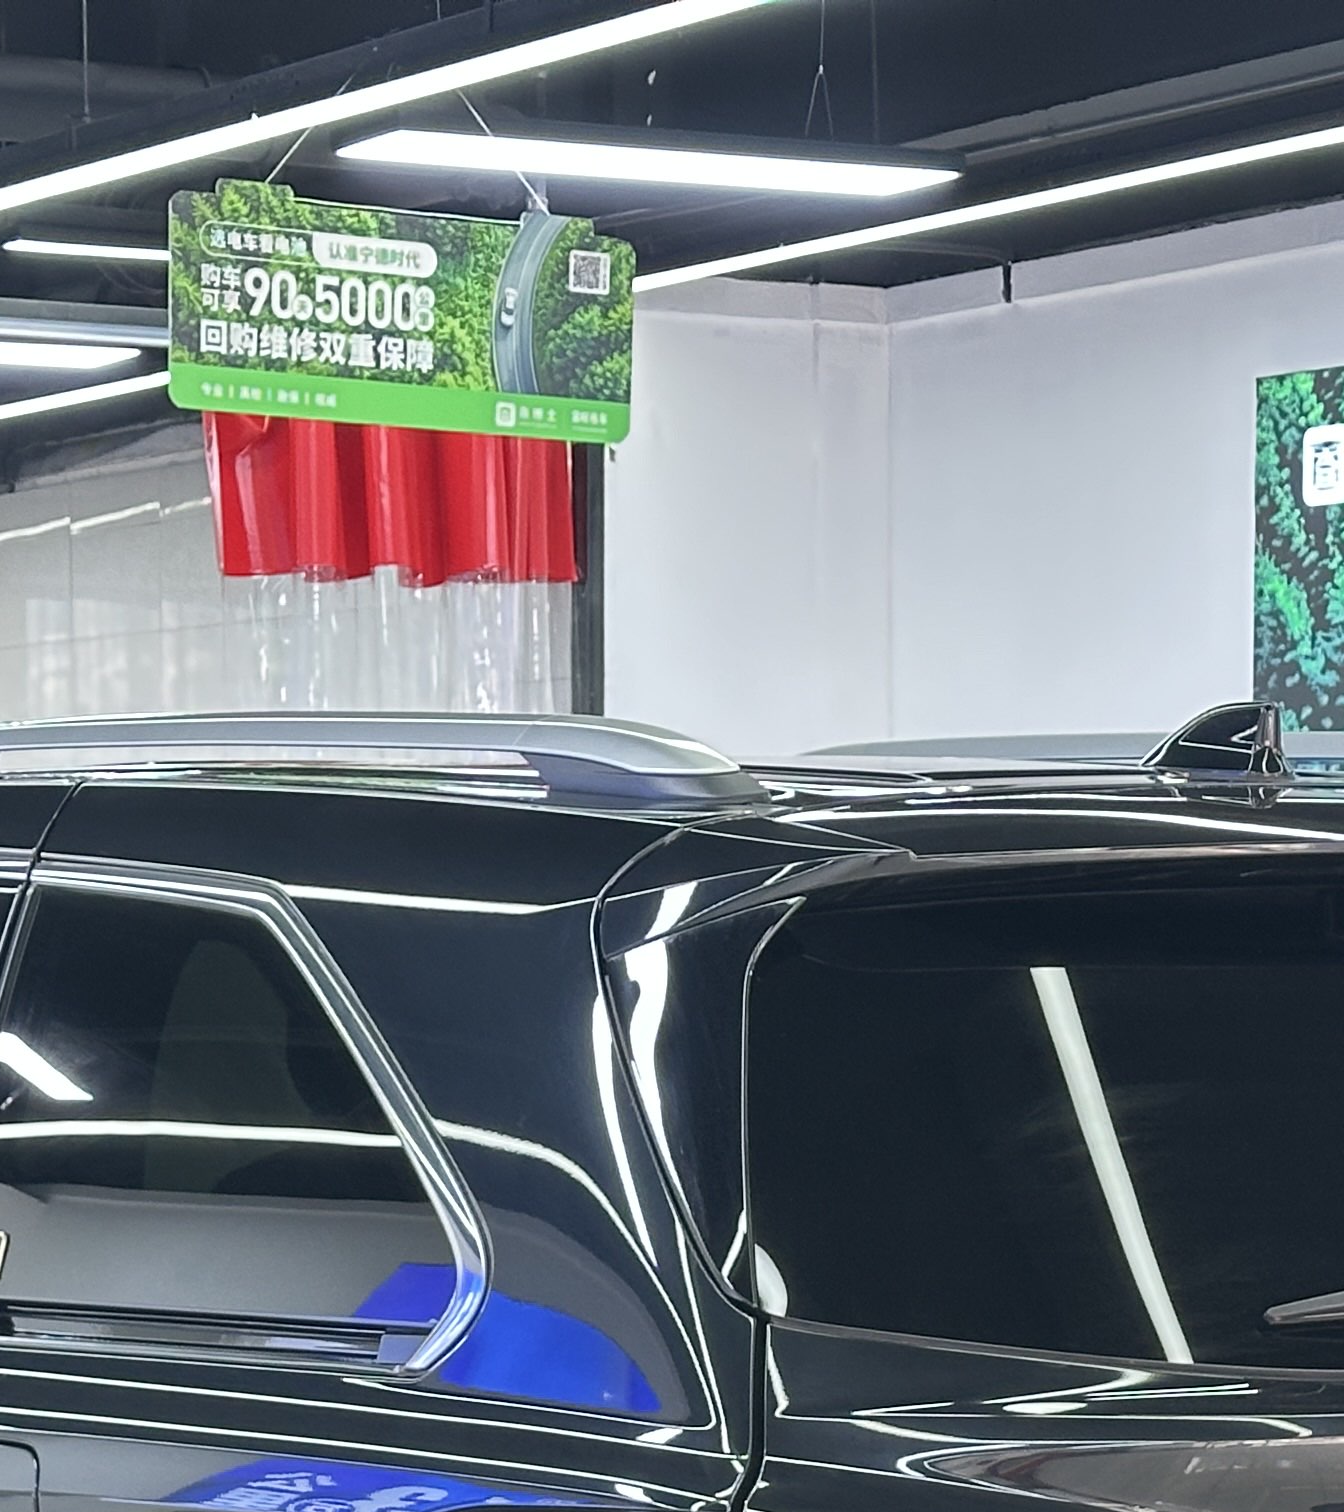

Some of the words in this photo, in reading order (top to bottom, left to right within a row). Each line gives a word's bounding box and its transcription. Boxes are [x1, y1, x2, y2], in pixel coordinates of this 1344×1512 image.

[200, 317, 436, 374] 回购维修双重保障
